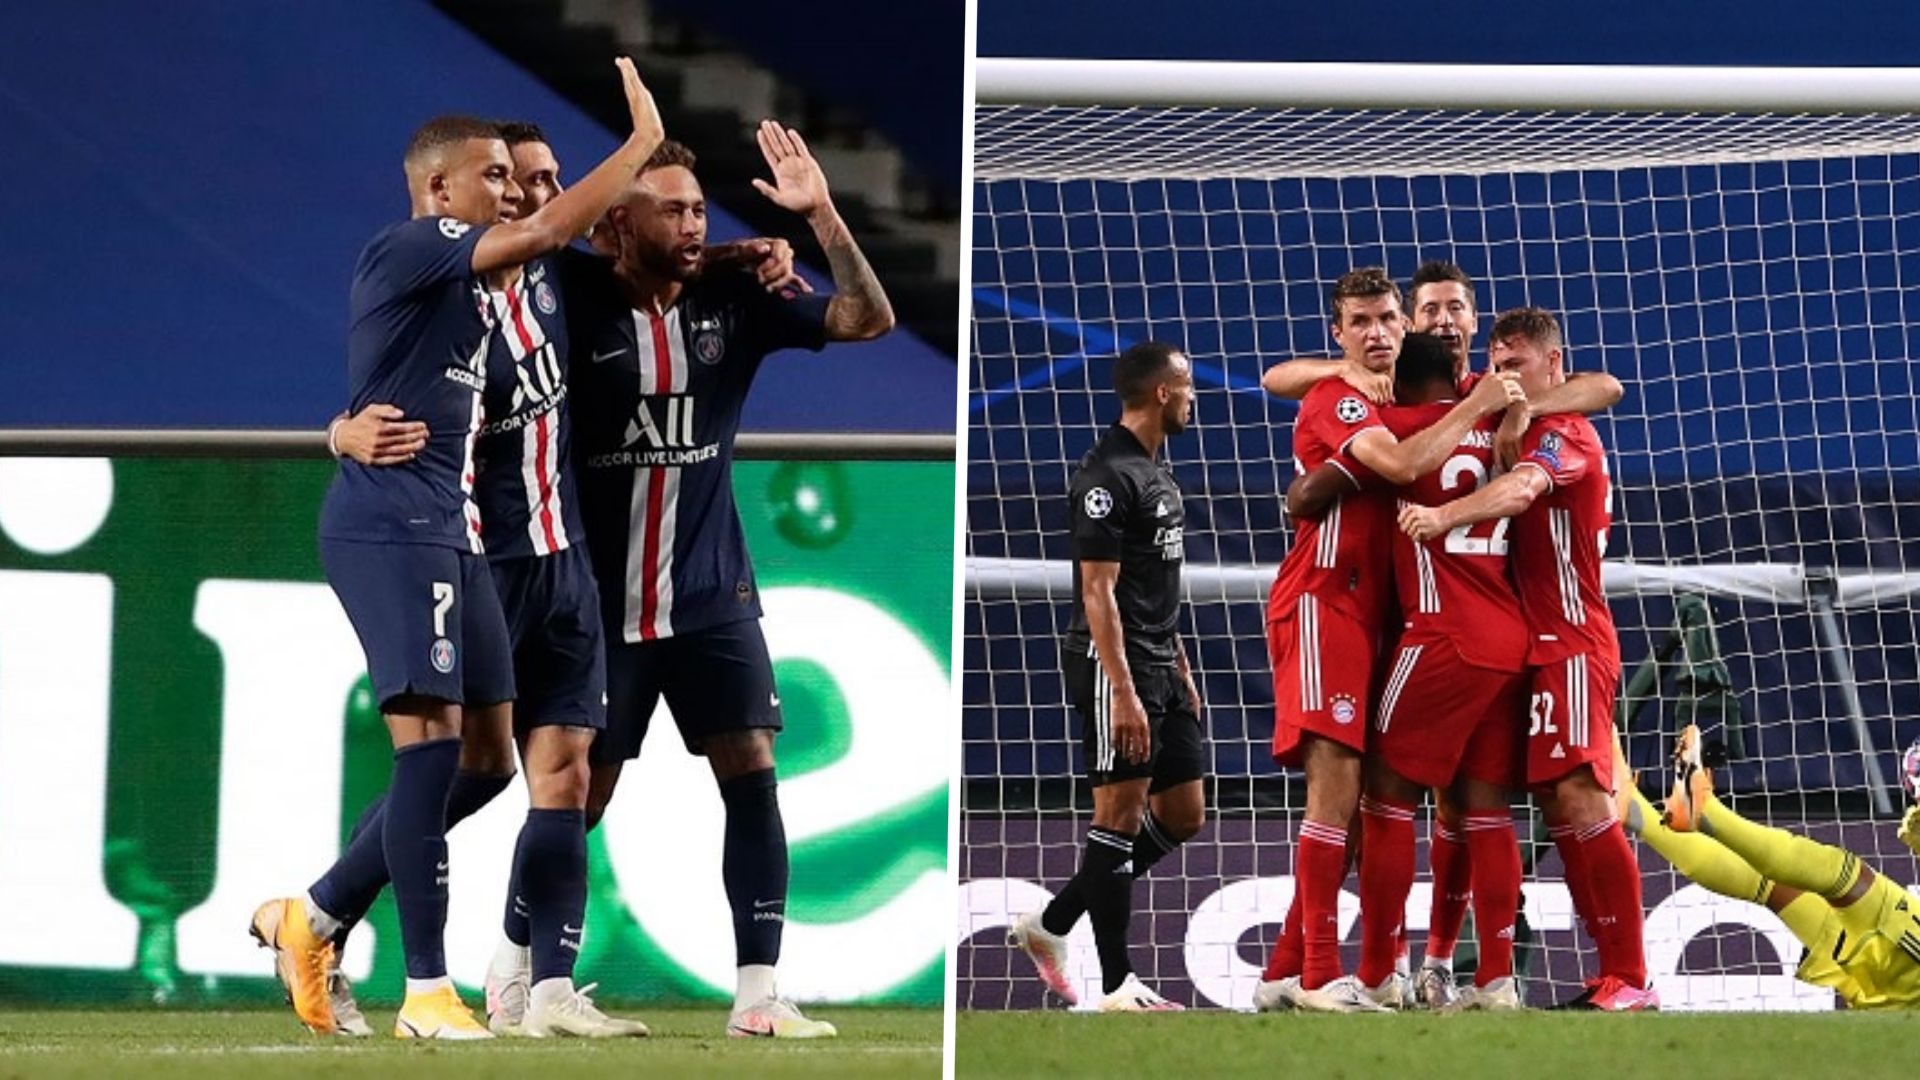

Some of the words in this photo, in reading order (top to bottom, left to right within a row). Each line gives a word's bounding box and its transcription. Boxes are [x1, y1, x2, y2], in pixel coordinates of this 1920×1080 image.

[479, 415, 523, 438] CCOR
[635, 451, 667, 465] LIVE
[432, 581, 455, 638] 7
